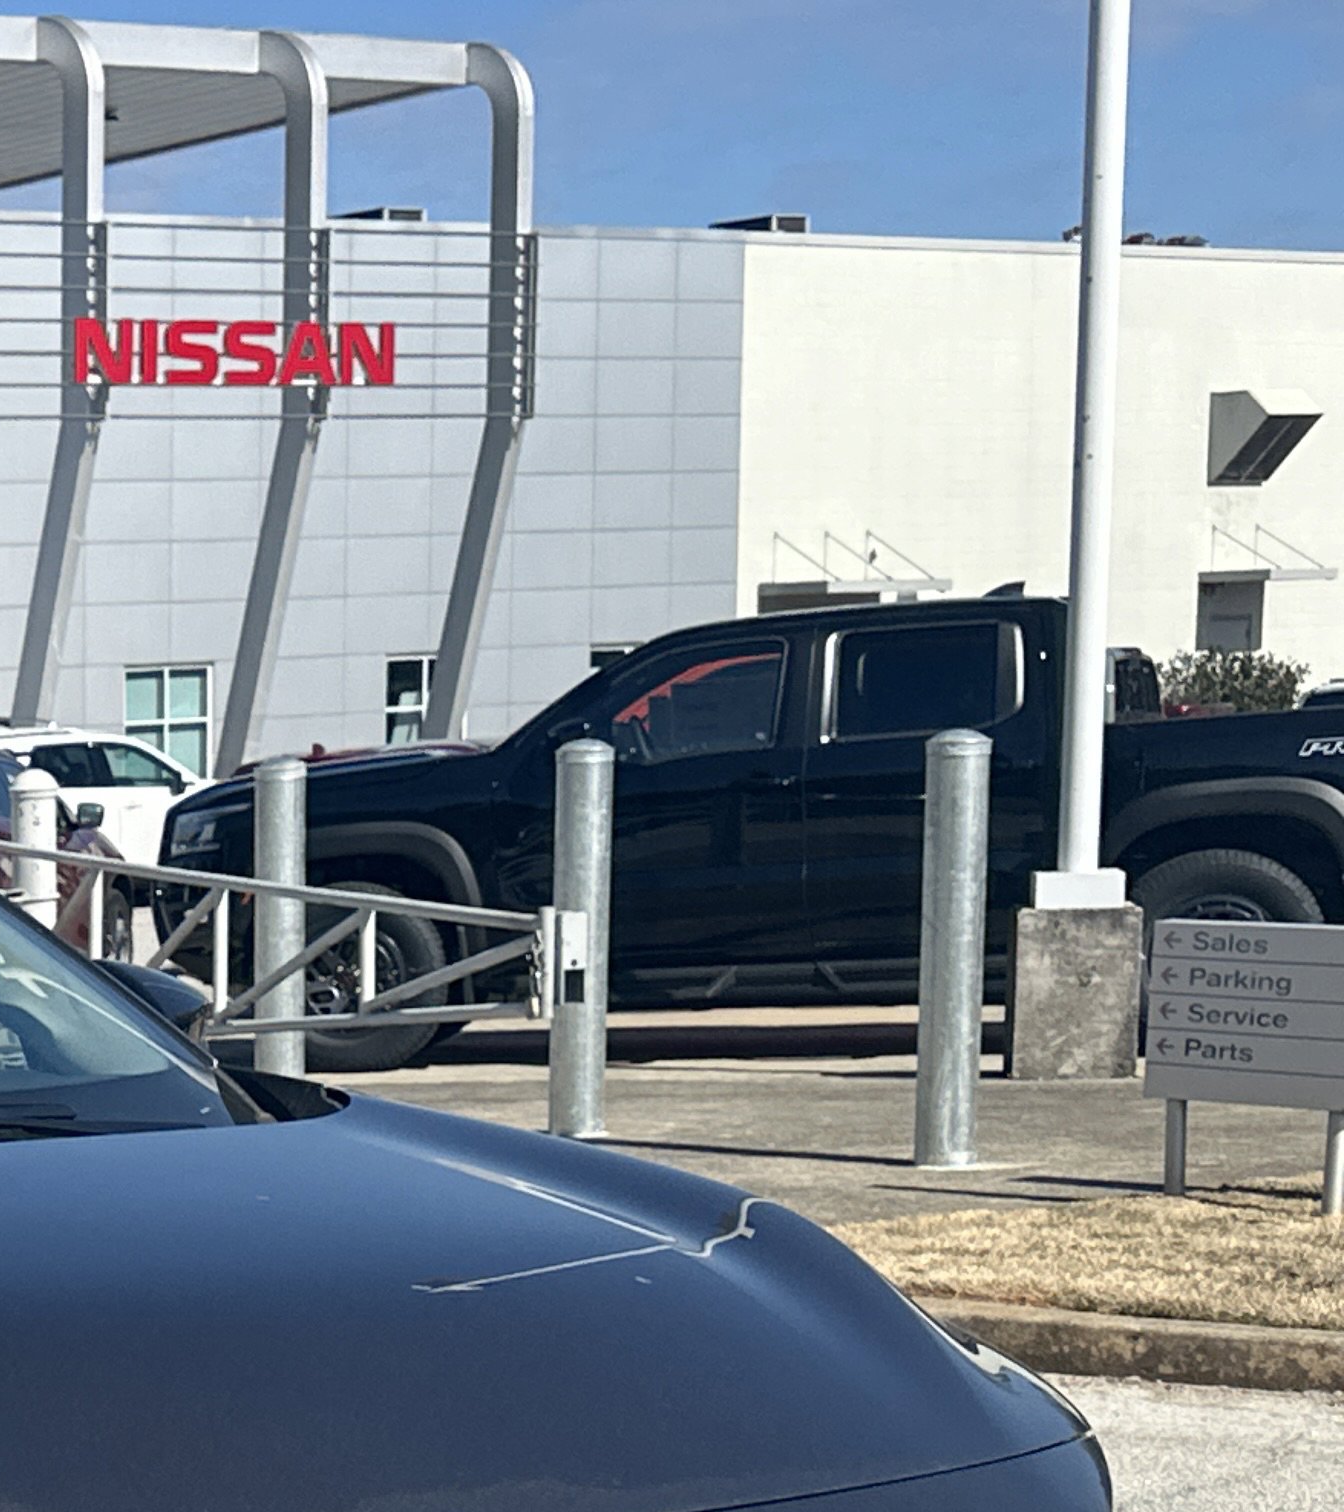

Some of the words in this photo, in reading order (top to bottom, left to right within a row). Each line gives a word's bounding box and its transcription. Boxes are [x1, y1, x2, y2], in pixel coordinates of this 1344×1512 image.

[73, 317, 395, 385] NISSAN
[1192, 931, 1269, 954] Sales
[1189, 967, 1292, 996] Parking
[1187, 1003, 1289, 1029] Service
[1184, 1038, 1253, 1063] Parts
